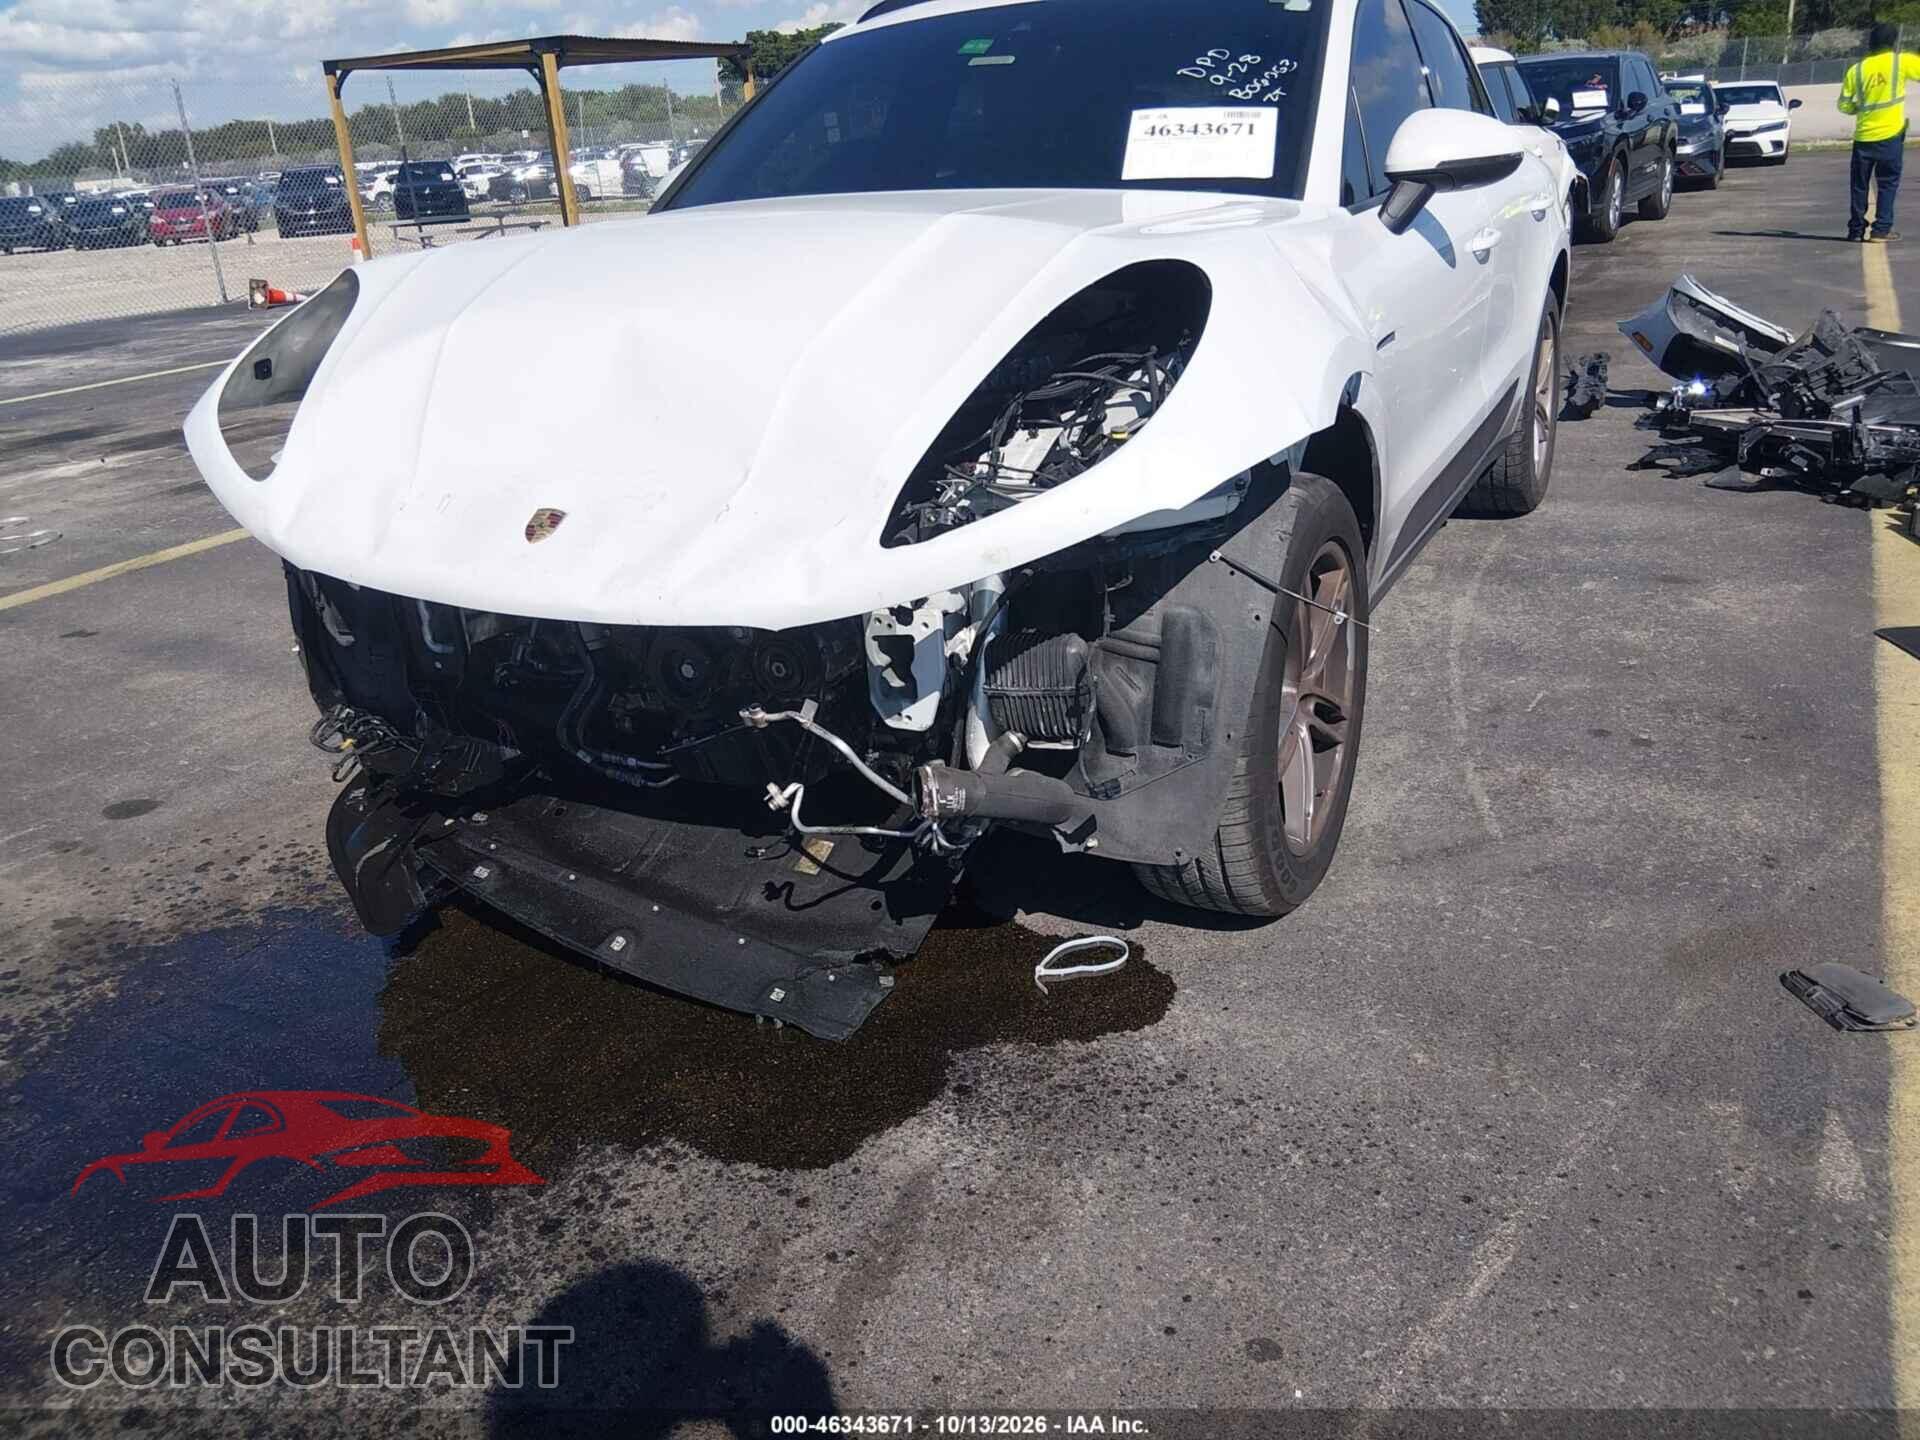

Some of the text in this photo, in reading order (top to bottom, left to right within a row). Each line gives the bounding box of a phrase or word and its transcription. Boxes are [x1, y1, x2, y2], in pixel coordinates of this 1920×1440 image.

[1176, 49, 1230, 78] DPD
[1210, 54, 1261, 86] 9-28
[1144, 122, 1256, 137] 46343671
